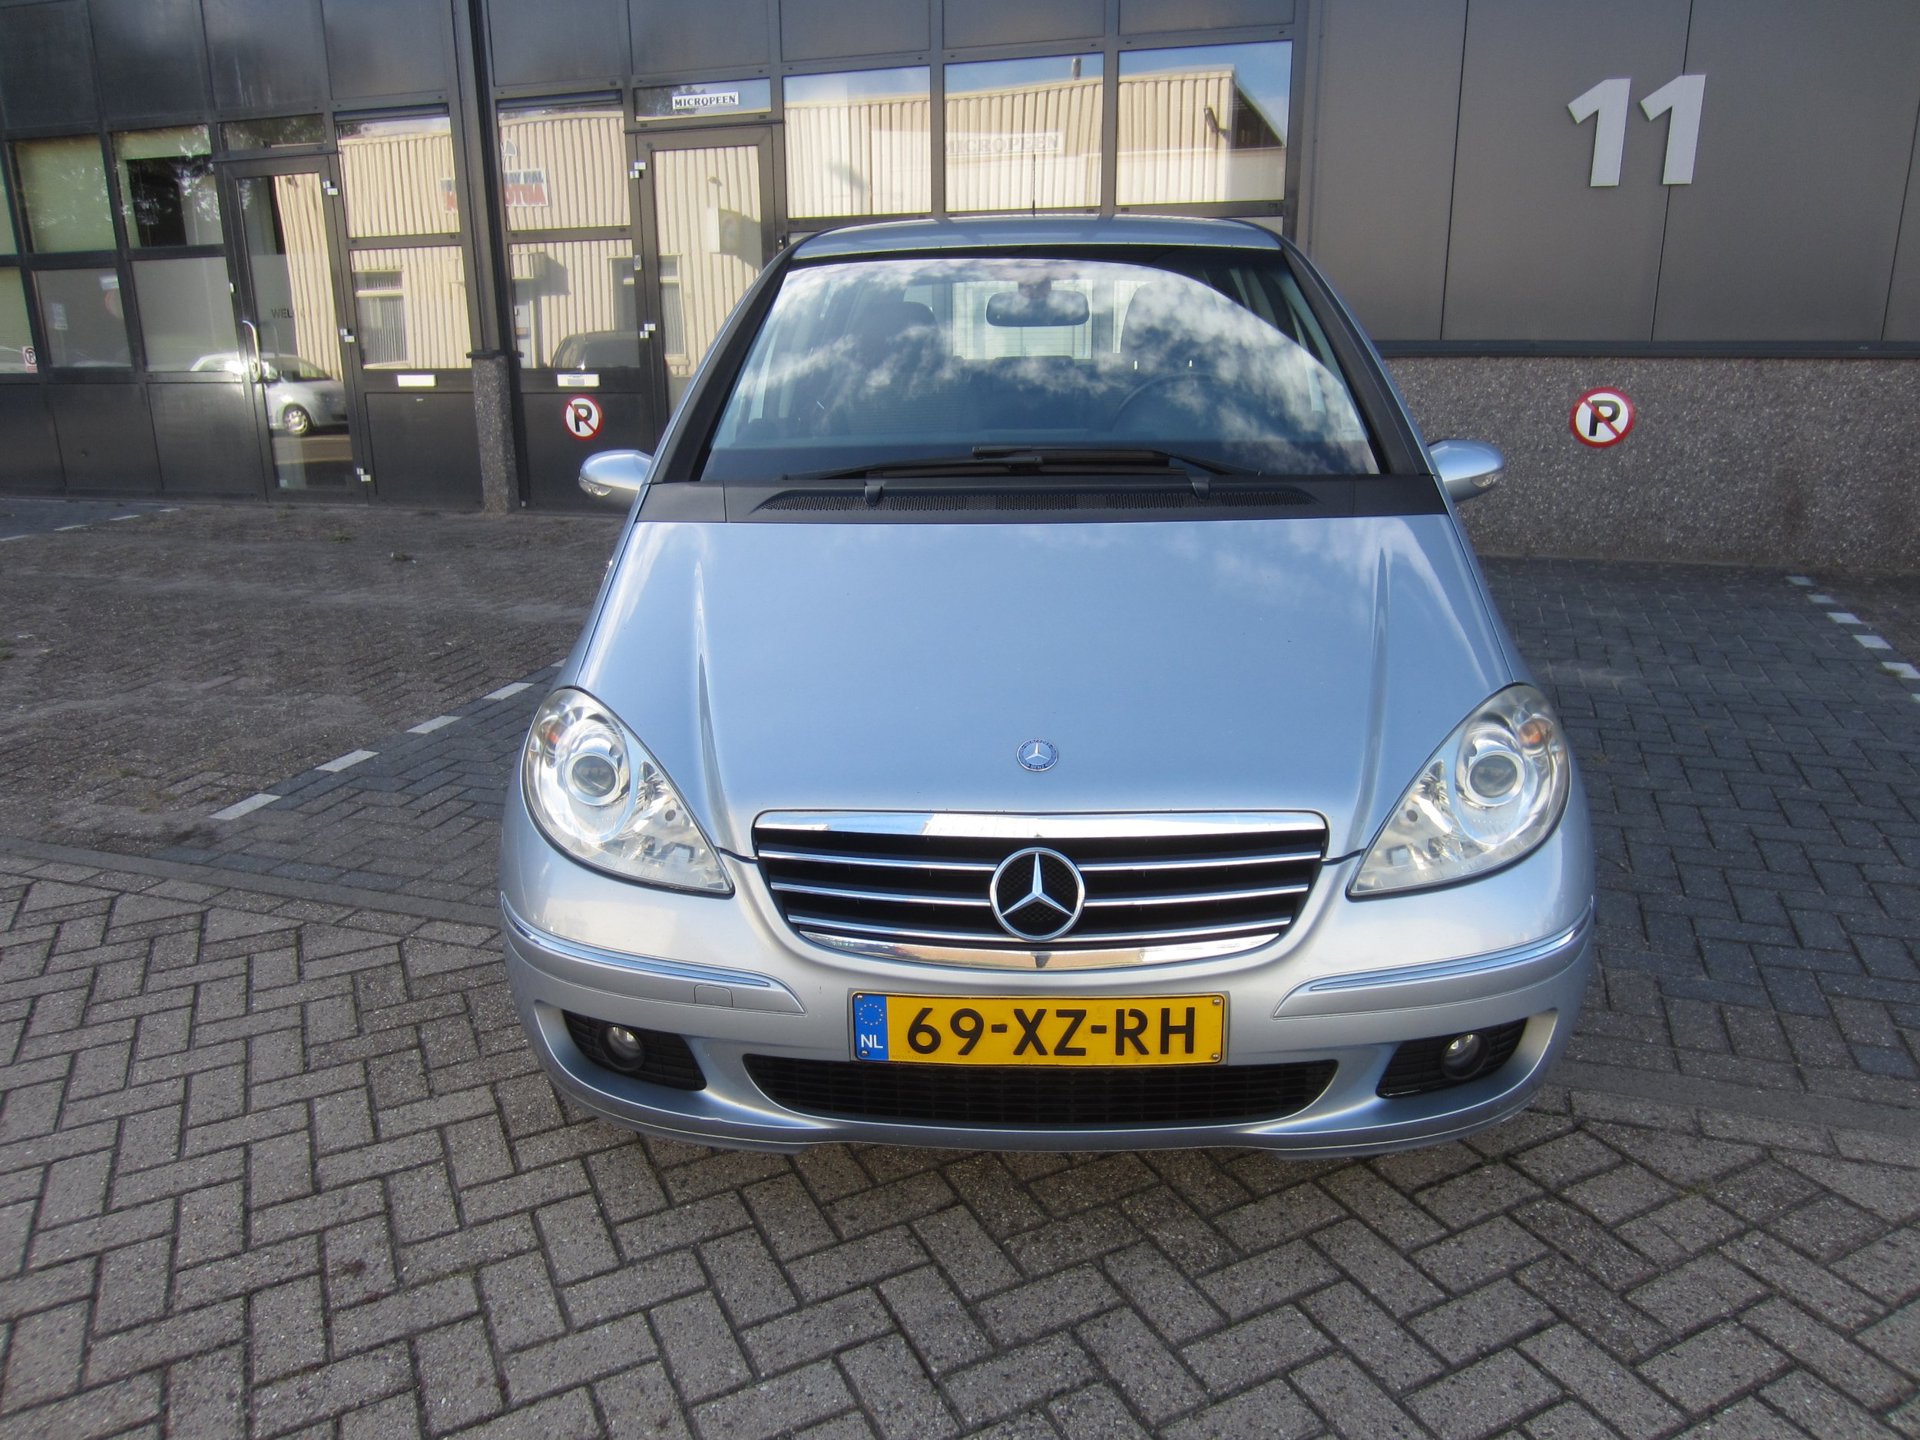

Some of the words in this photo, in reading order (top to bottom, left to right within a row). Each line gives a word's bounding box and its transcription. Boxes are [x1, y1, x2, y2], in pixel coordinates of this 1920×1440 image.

[1567, 74, 1706, 187] 11
[860, 1034, 883, 1049] NL
[907, 1007, 1195, 1056] 69-XZ-RH
